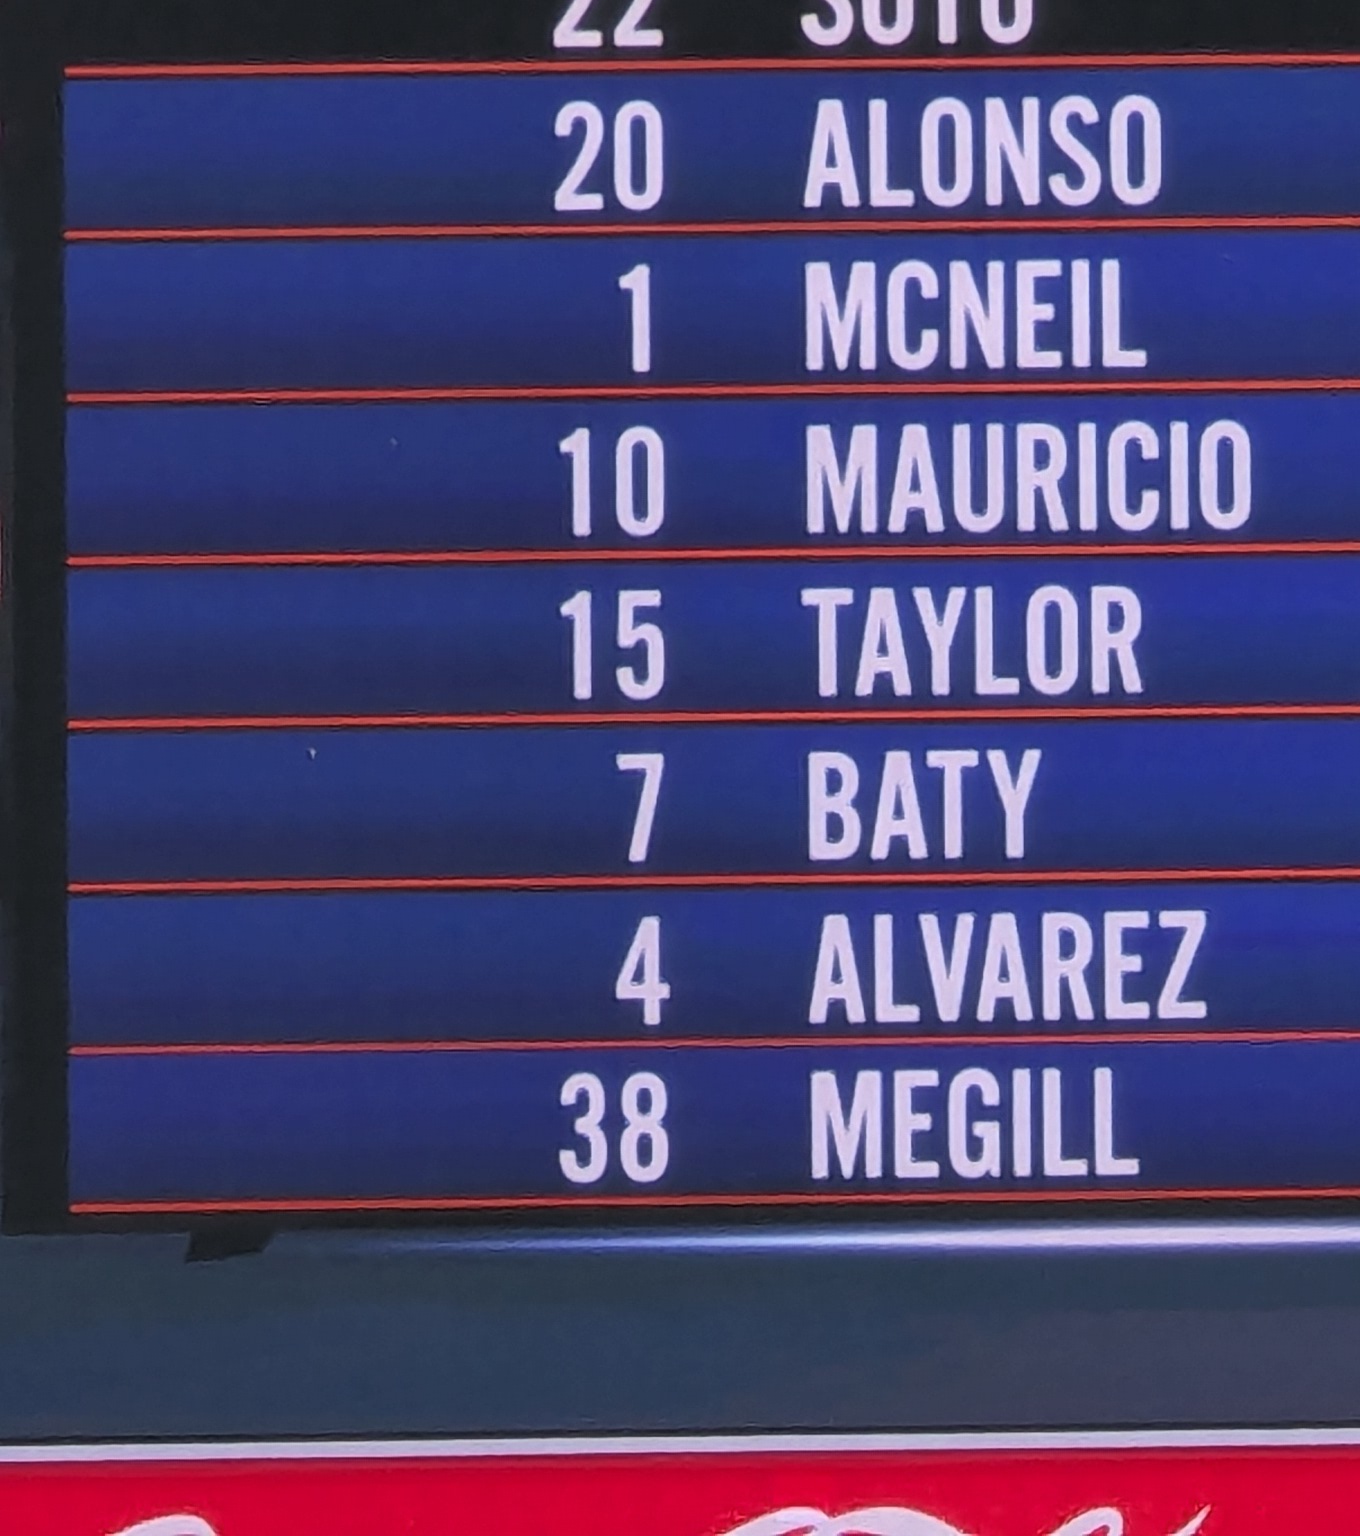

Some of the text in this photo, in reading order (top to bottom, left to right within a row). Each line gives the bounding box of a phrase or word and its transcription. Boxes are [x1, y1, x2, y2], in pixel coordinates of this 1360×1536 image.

[554, 100, 664, 211] 20
[803, 94, 1162, 208] ALONSO
[618, 263, 651, 373] 1
[805, 258, 1148, 371] MCNEIL
[559, 425, 665, 537] 10
[806, 419, 1252, 534] MAURICIO
[559, 589, 665, 700] 15
[800, 584, 1144, 697] TAYLOR
[616, 753, 665, 863] 7
[808, 748, 1042, 861] BATY
[615, 916, 671, 1026] 4
[808, 910, 1208, 1024] ALVAREZ
[559, 1071, 669, 1184] 38
[810, 1067, 1140, 1179] MEGILL
